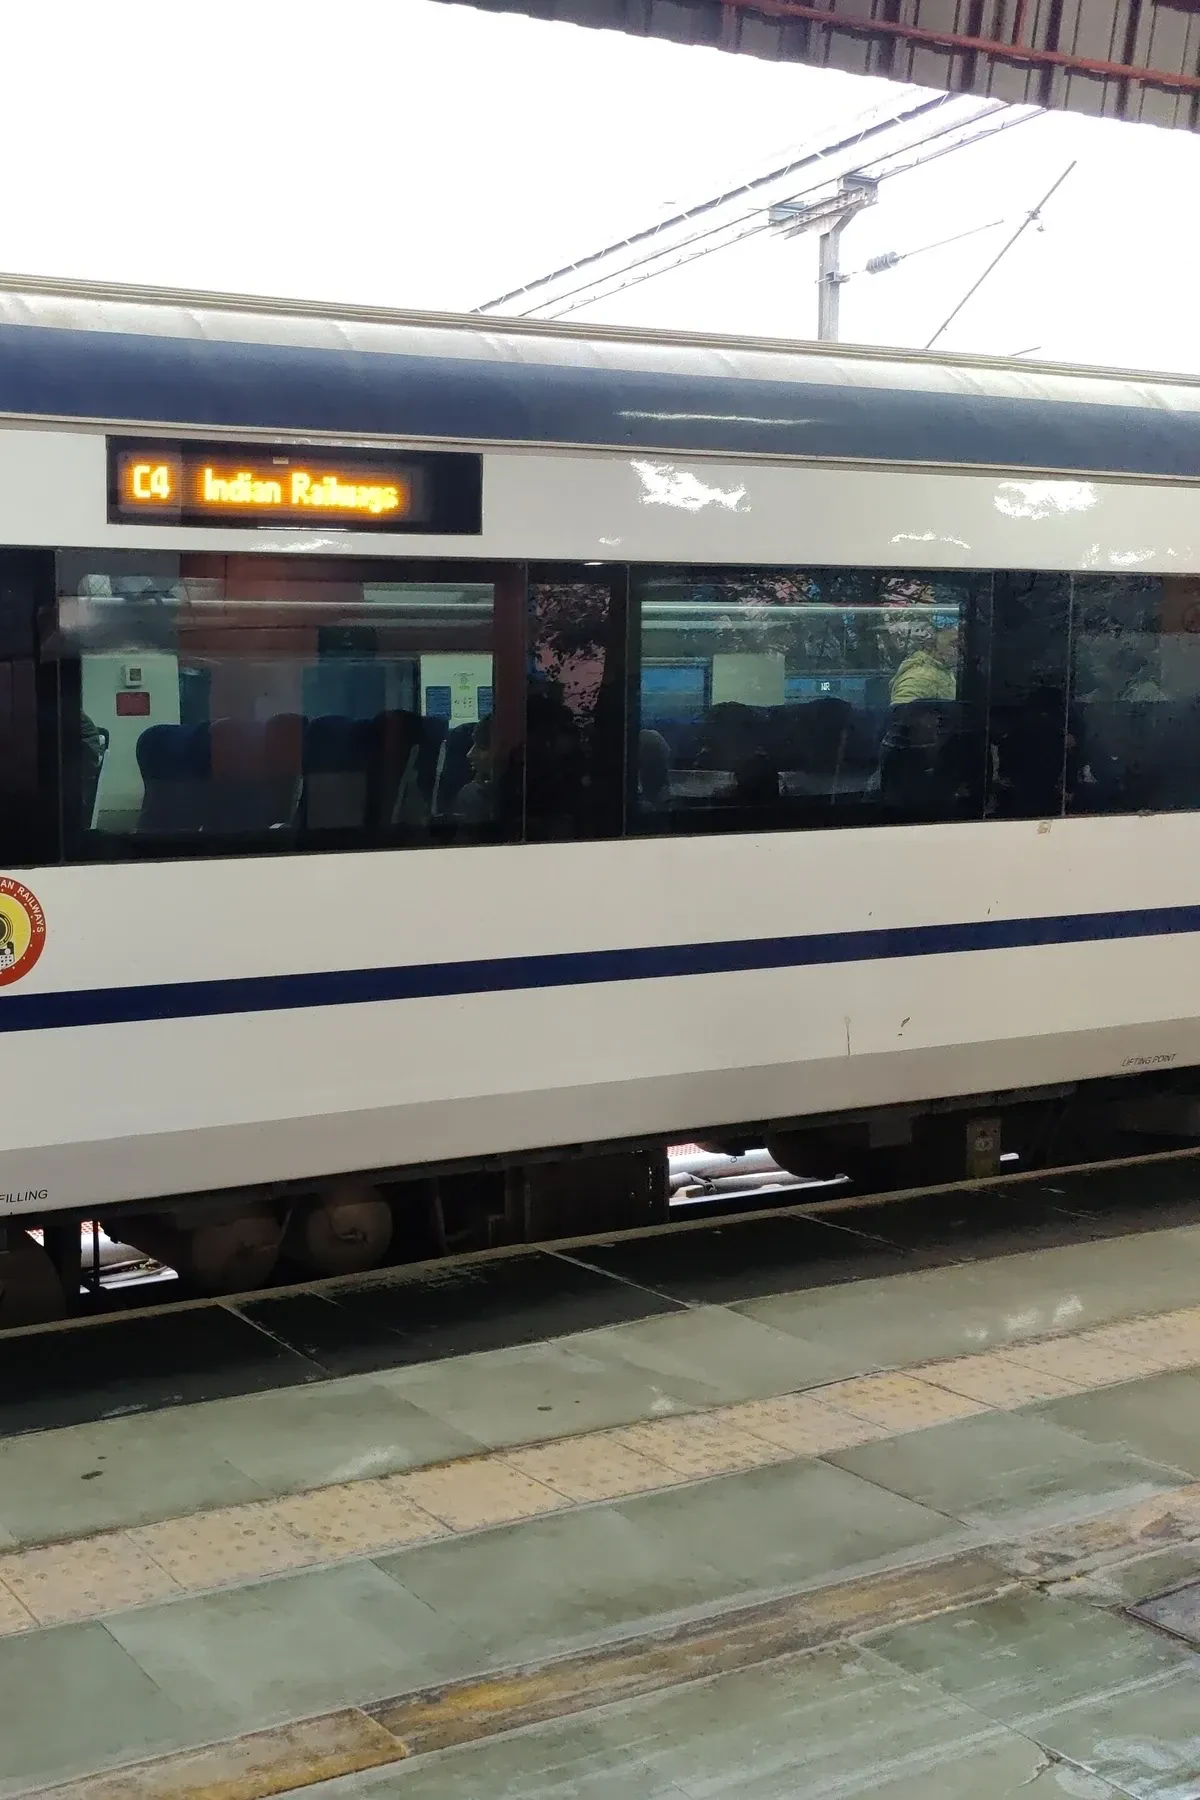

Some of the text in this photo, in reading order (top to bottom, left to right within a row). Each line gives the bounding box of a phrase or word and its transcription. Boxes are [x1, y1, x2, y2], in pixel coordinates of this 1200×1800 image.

[132, 465, 399, 514] C4 Indian Railways
[17, 887, 44, 932] RAILWAYS
[1121, 1053, 1177, 1067] LIFTING POINT
